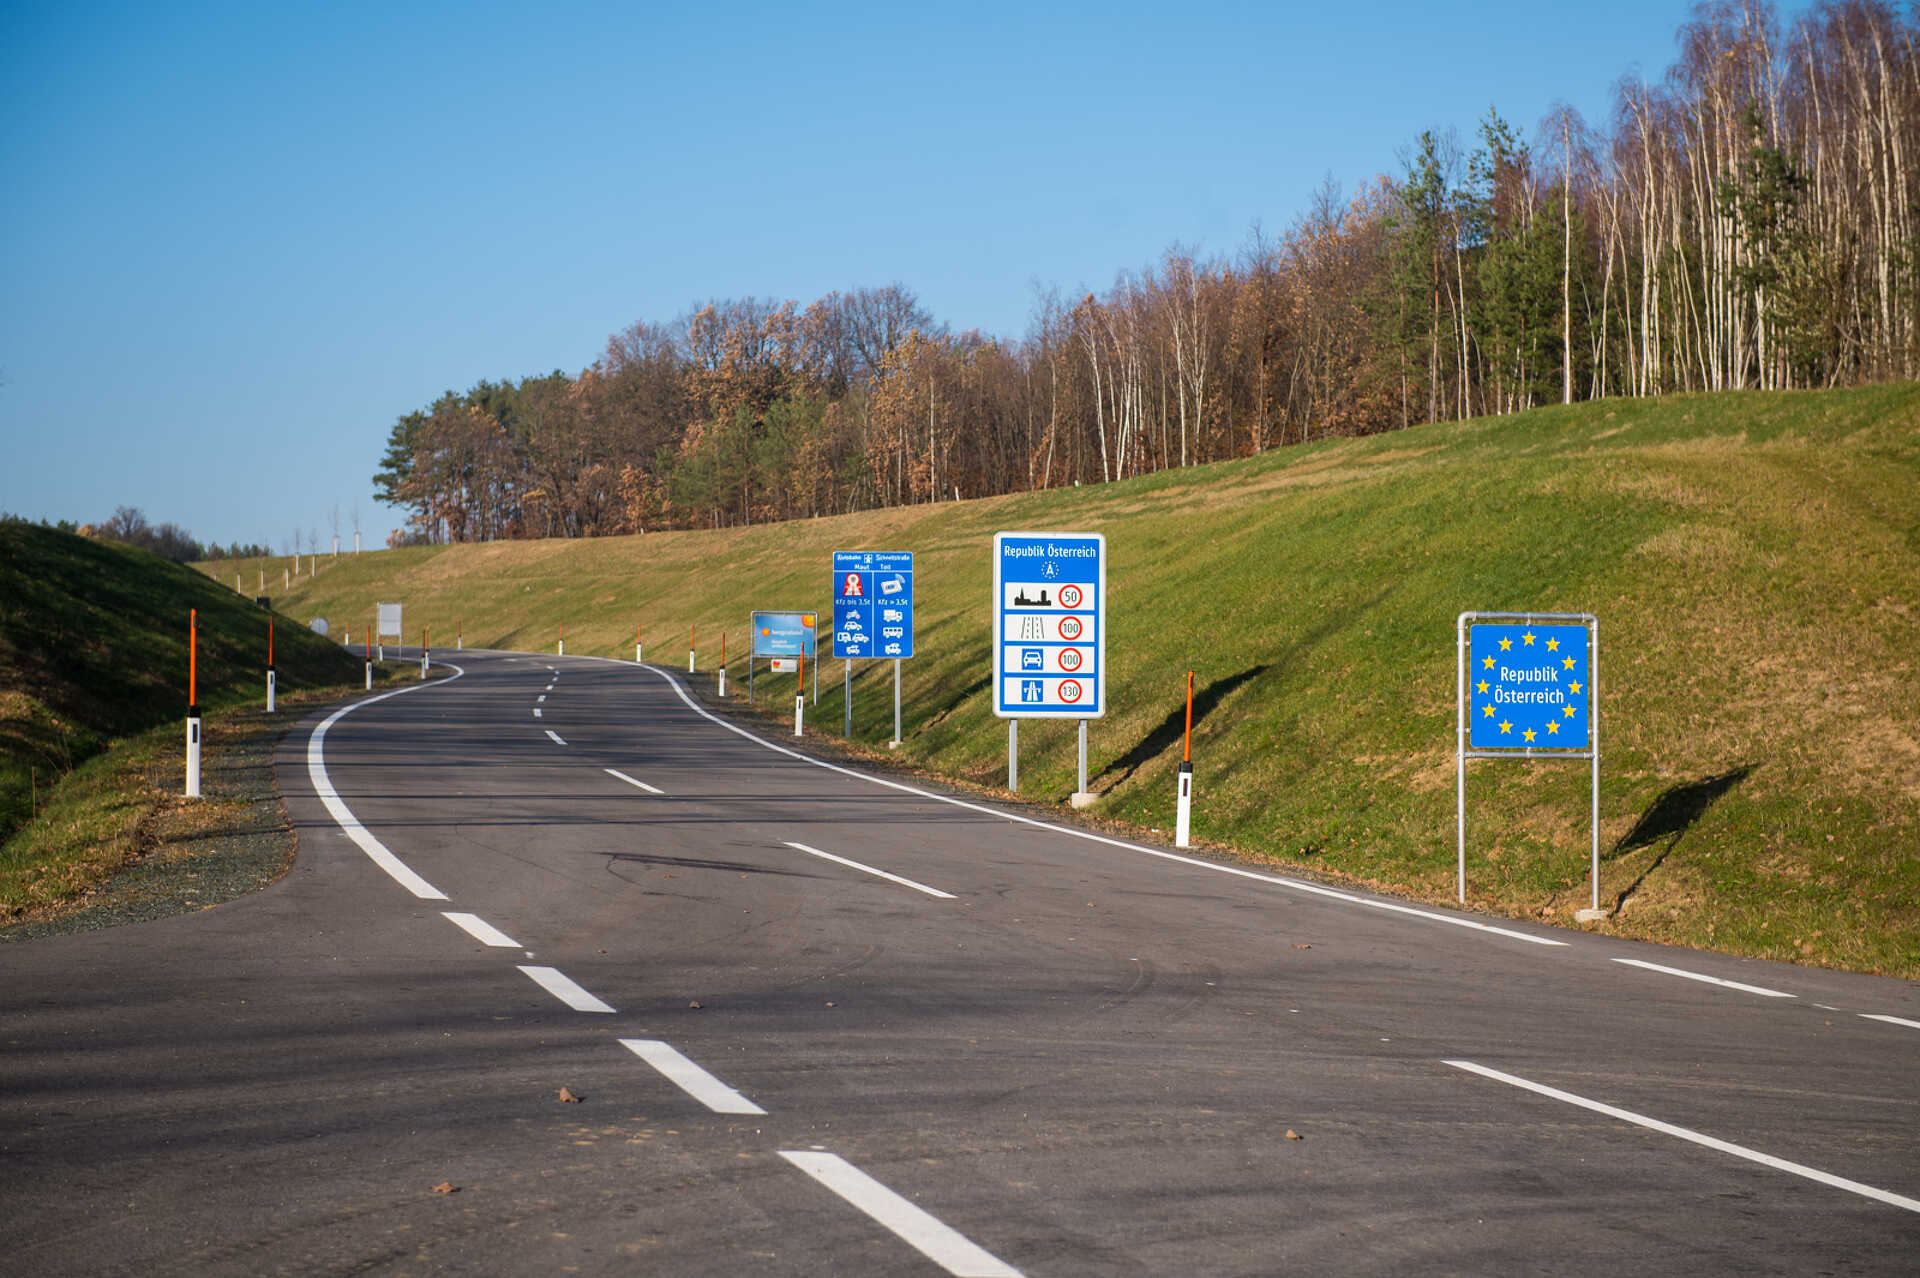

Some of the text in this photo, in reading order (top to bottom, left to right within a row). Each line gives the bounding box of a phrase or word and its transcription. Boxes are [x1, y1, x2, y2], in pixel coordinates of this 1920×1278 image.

[1004, 543, 1096, 558] Republik Österreich
[1064, 591, 1077, 602] 50
[1063, 623, 1079, 634] 100
[1063, 654, 1079, 665] 100
[1500, 666, 1558, 685] Republik
[1063, 686, 1079, 697] 130
[1494, 685, 1564, 704] Österreich
